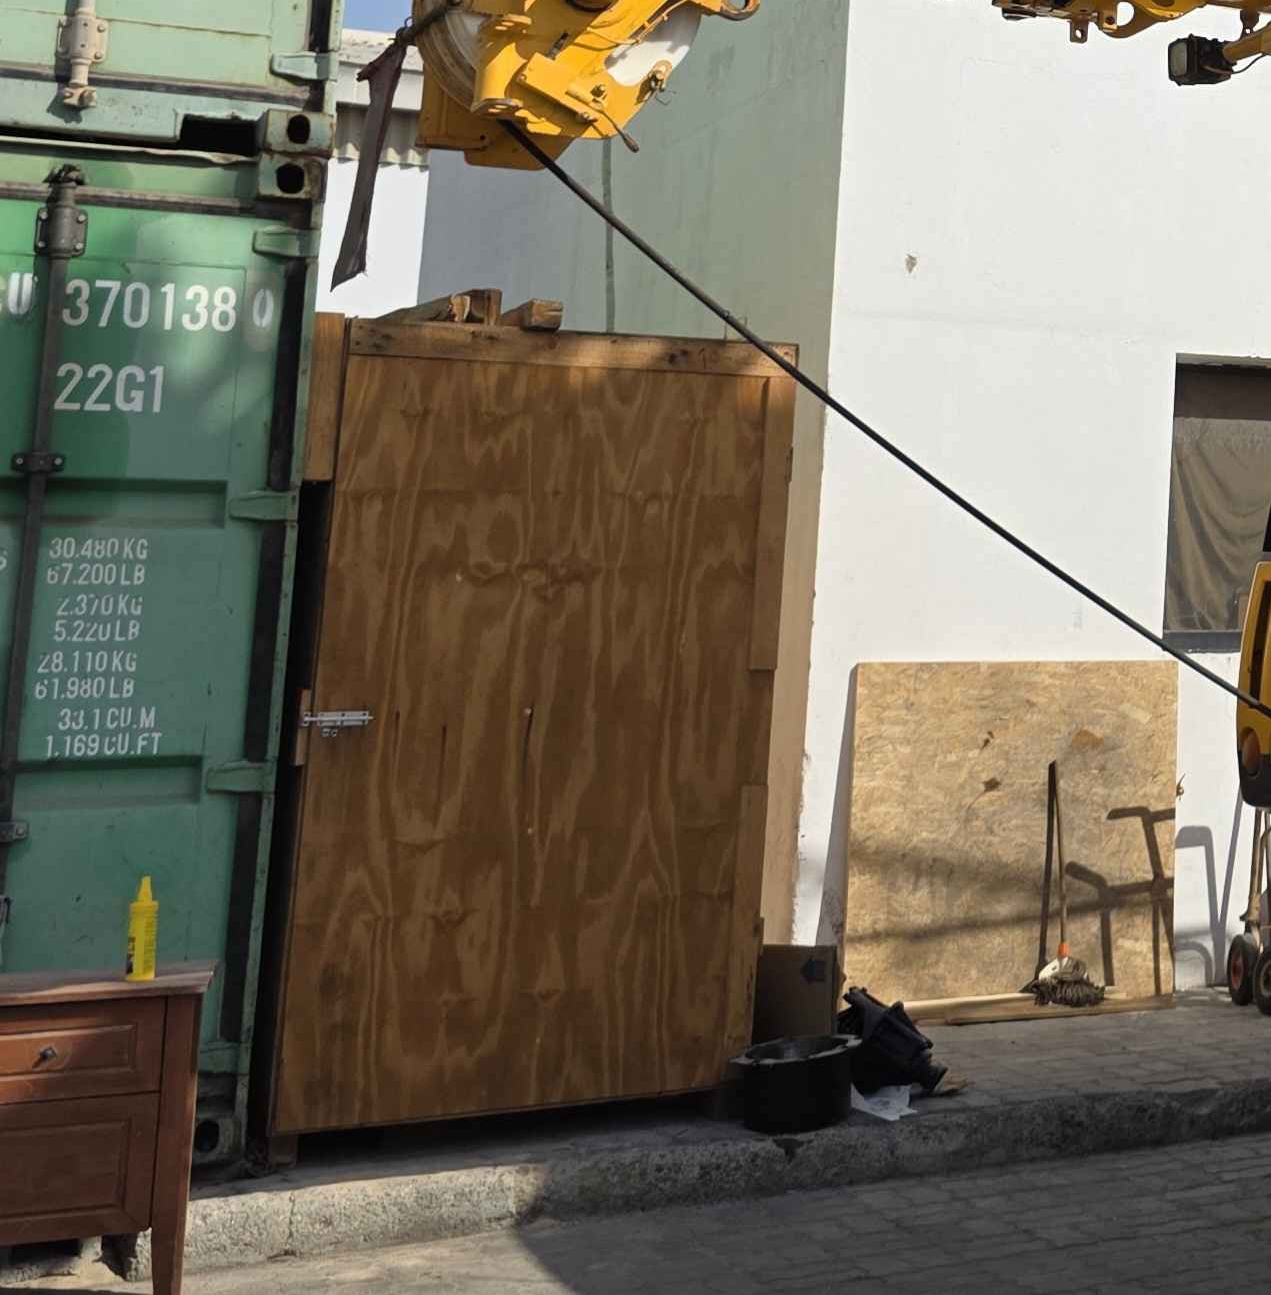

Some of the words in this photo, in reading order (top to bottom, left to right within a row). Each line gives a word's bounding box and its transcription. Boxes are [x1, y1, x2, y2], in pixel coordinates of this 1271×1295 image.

[61, 279, 238, 332] 370138
[54, 362, 165, 413] 22G1
[50, 537, 119, 559] 30.480
[122, 537, 148, 560] KG
[47, 563, 116, 585] 67.200
[120, 564, 145, 585] LB
[57, 593, 114, 616] 2.370
[117, 593, 143, 616] KG
[53, 619, 111, 642] 5.220
[114, 619, 140, 641] LB
[37, 650, 108, 674] 28.110
[111, 650, 137, 673] KG
[34, 676, 105, 700] 61.980
[109, 676, 135, 699] LB
[58, 707, 100, 731] 33.1
[106, 707, 156, 730] CU.M
[46, 733, 100, 758] 1.169
[103, 732, 162, 756] CU.FT
